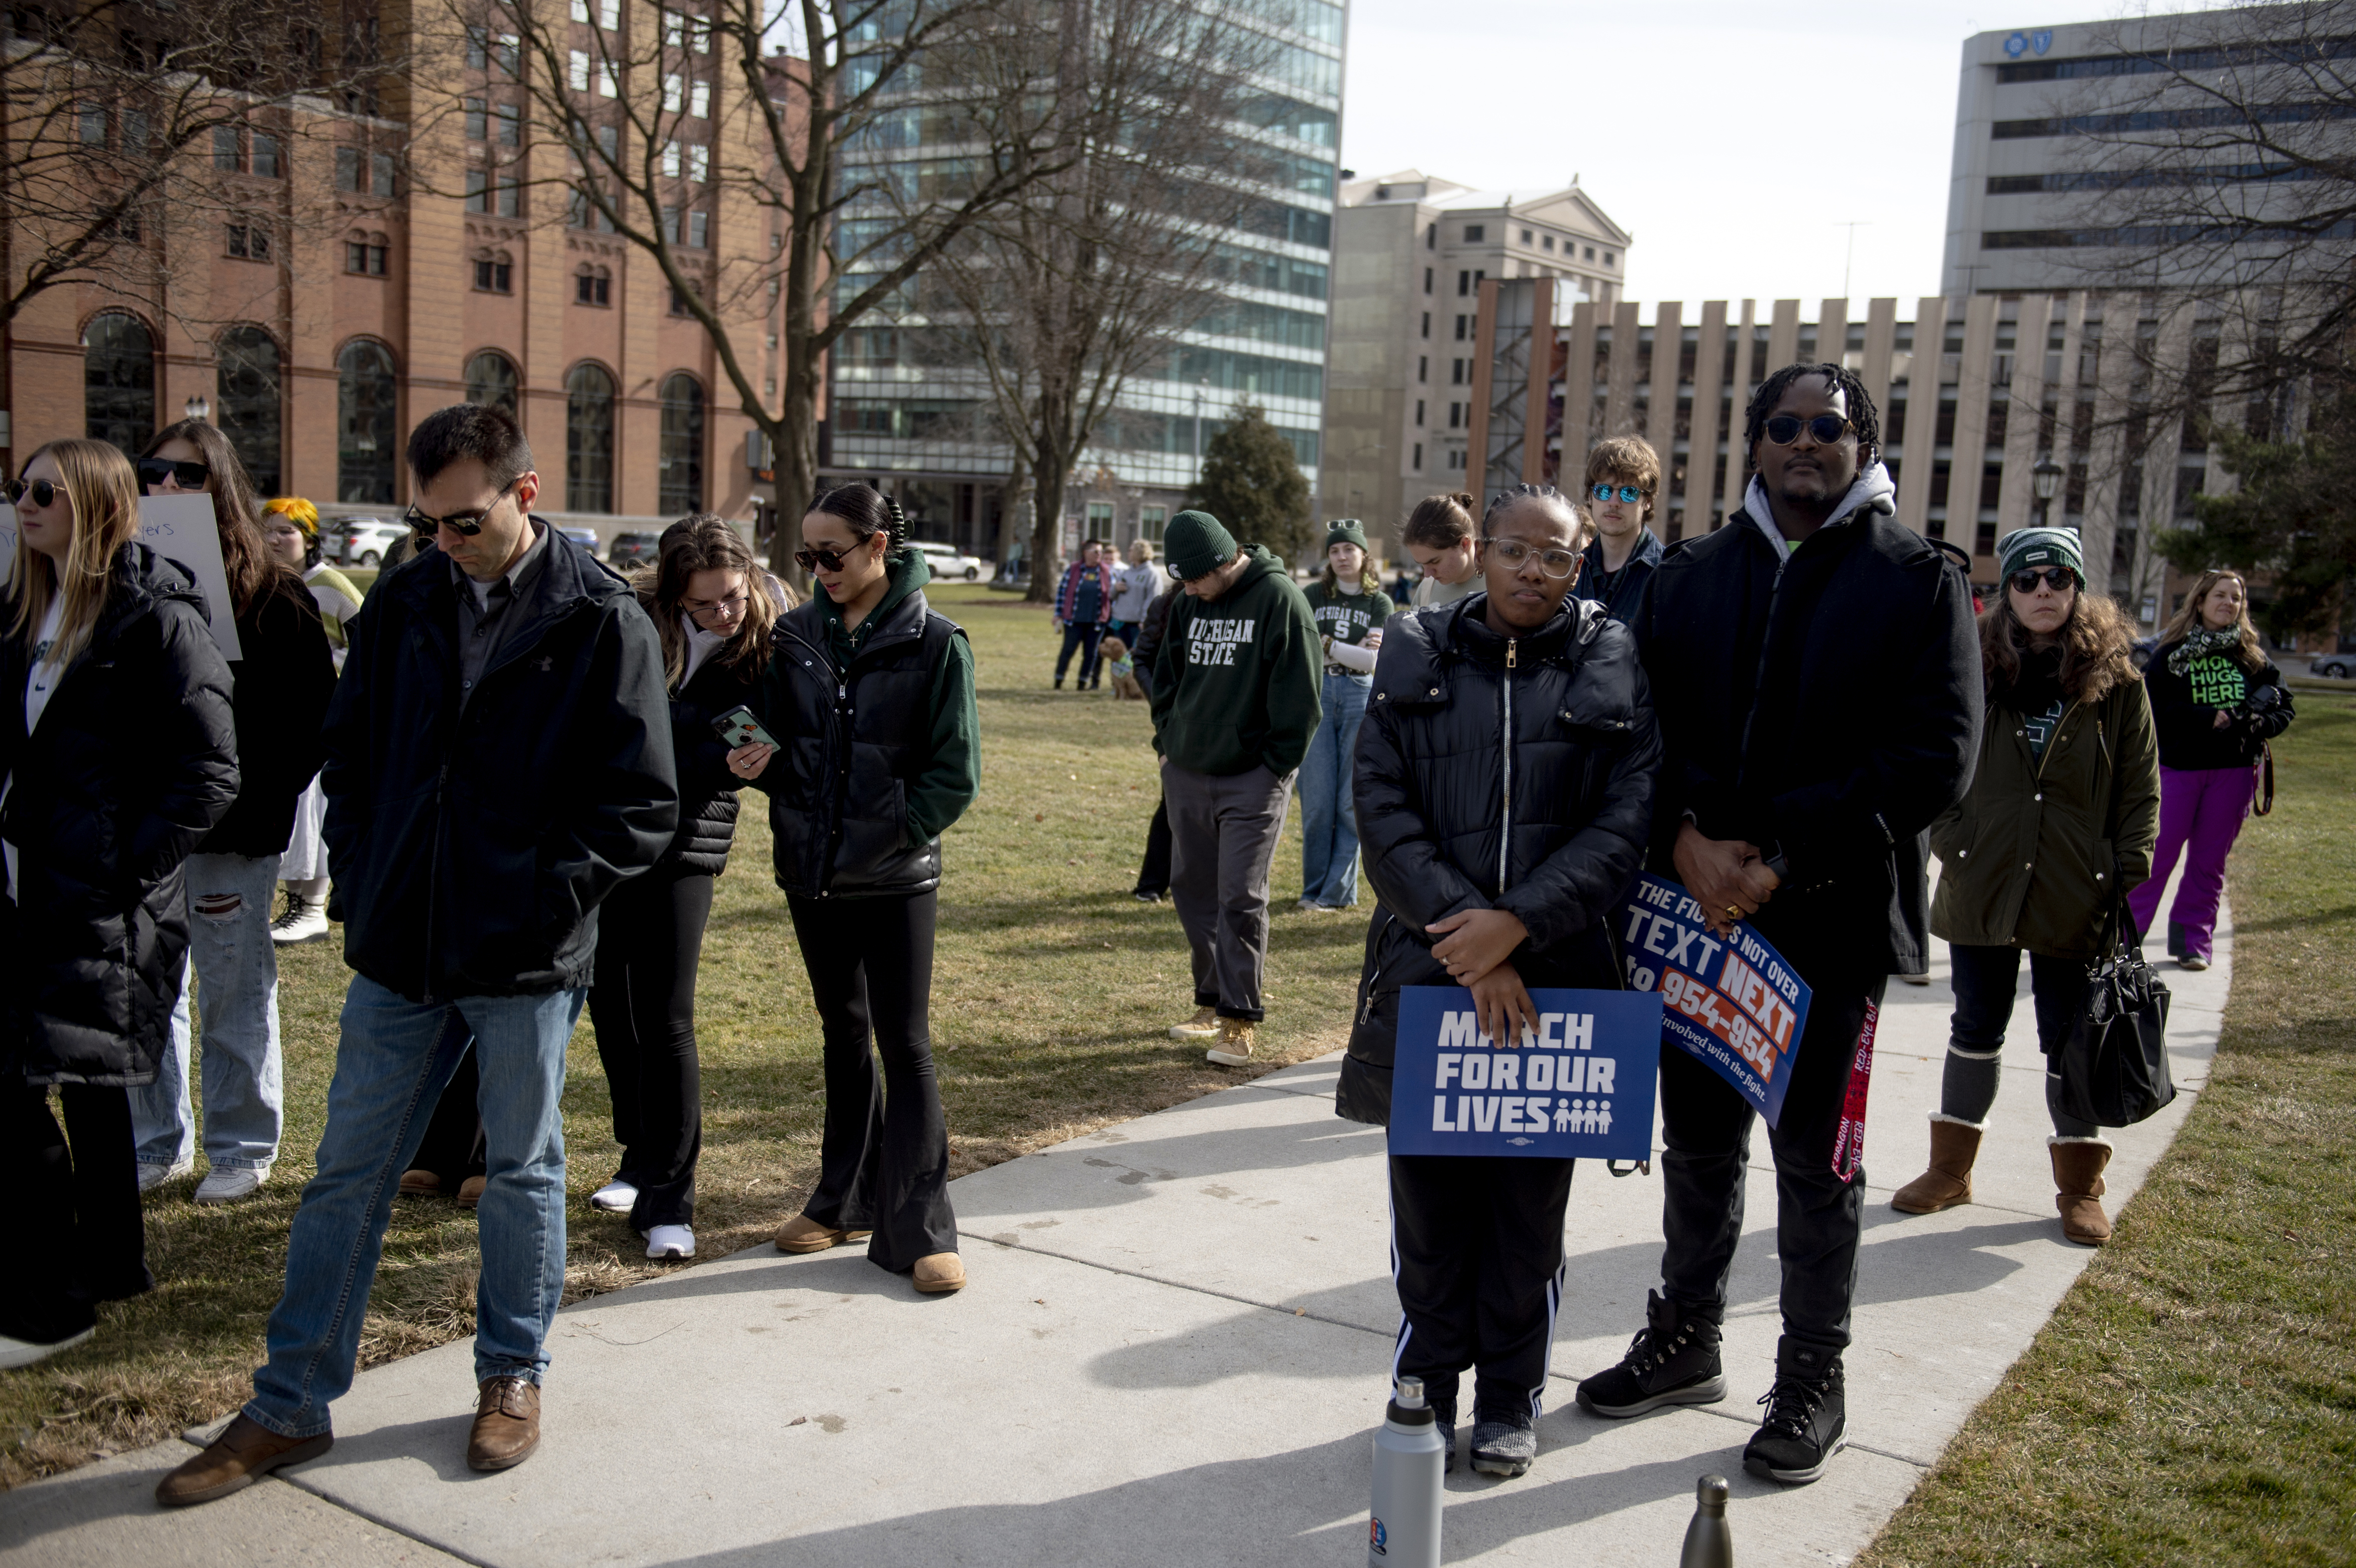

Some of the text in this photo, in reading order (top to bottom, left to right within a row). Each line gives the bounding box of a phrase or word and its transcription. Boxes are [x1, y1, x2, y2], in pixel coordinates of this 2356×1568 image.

[1334, 620, 1350, 639] S
[2191, 669, 2243, 686] HUGS
[2192, 683, 2245, 704] HERE
[1637, 880, 1799, 1004] THE FIG S NOT OVER
[1626, 904, 1794, 1045] TEXT NEXT
[1626, 955, 1773, 1078] to 954-954
[1661, 1014, 1708, 1048] involved
[1707, 1043, 1731, 1066] with
[1730, 1061, 1746, 1079] the
[1742, 1074, 1765, 1102] fight.
[1854, 1022, 1874, 1071] RED-EYE
[1435, 1053, 1616, 1094] FOR OUR
[1432, 1095, 1551, 1133] LIVES
[1834, 1116, 1850, 1163] DRAGON
